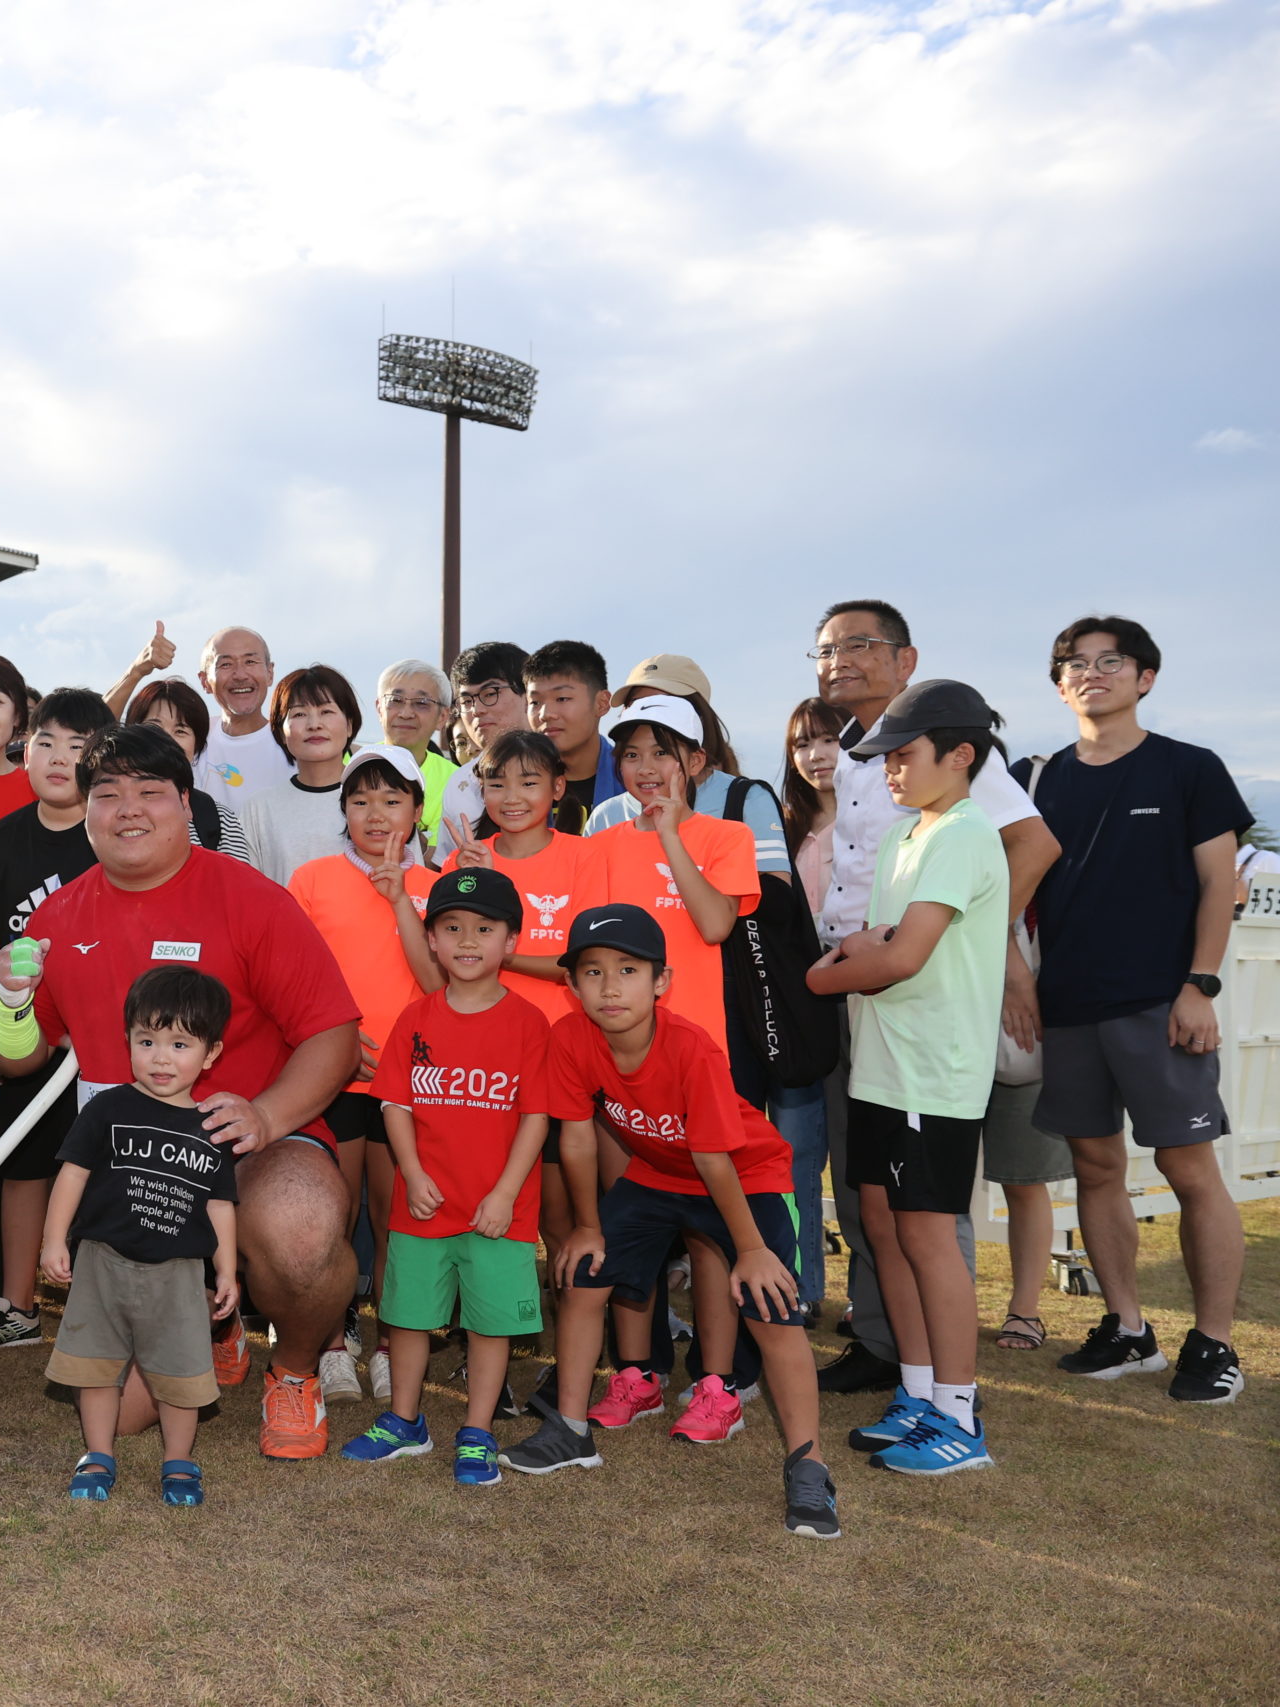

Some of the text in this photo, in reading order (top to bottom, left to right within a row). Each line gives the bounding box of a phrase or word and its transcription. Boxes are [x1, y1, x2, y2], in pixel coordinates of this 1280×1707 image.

[655, 897, 686, 910] FPT
[530, 929, 564, 941] FPTC
[746, 919, 764, 964] DEAN
[155, 945, 196, 957] SENKO
[413, 1096, 442, 1105] ATHLETE
[444, 1098, 465, 1106] NIGHT
[466, 1099, 490, 1109] GAMES
[121, 1138, 152, 1158] J.J
[130, 1175, 146, 1187] We
[147, 1180, 168, 1193] wish
[126, 1188, 143, 1199] will
[144, 1191, 169, 1207] bring
[170, 1197, 188, 1211] smile
[131, 1202, 163, 1219] people
[163, 1210, 174, 1220] all
[140, 1217, 156, 1230] the
